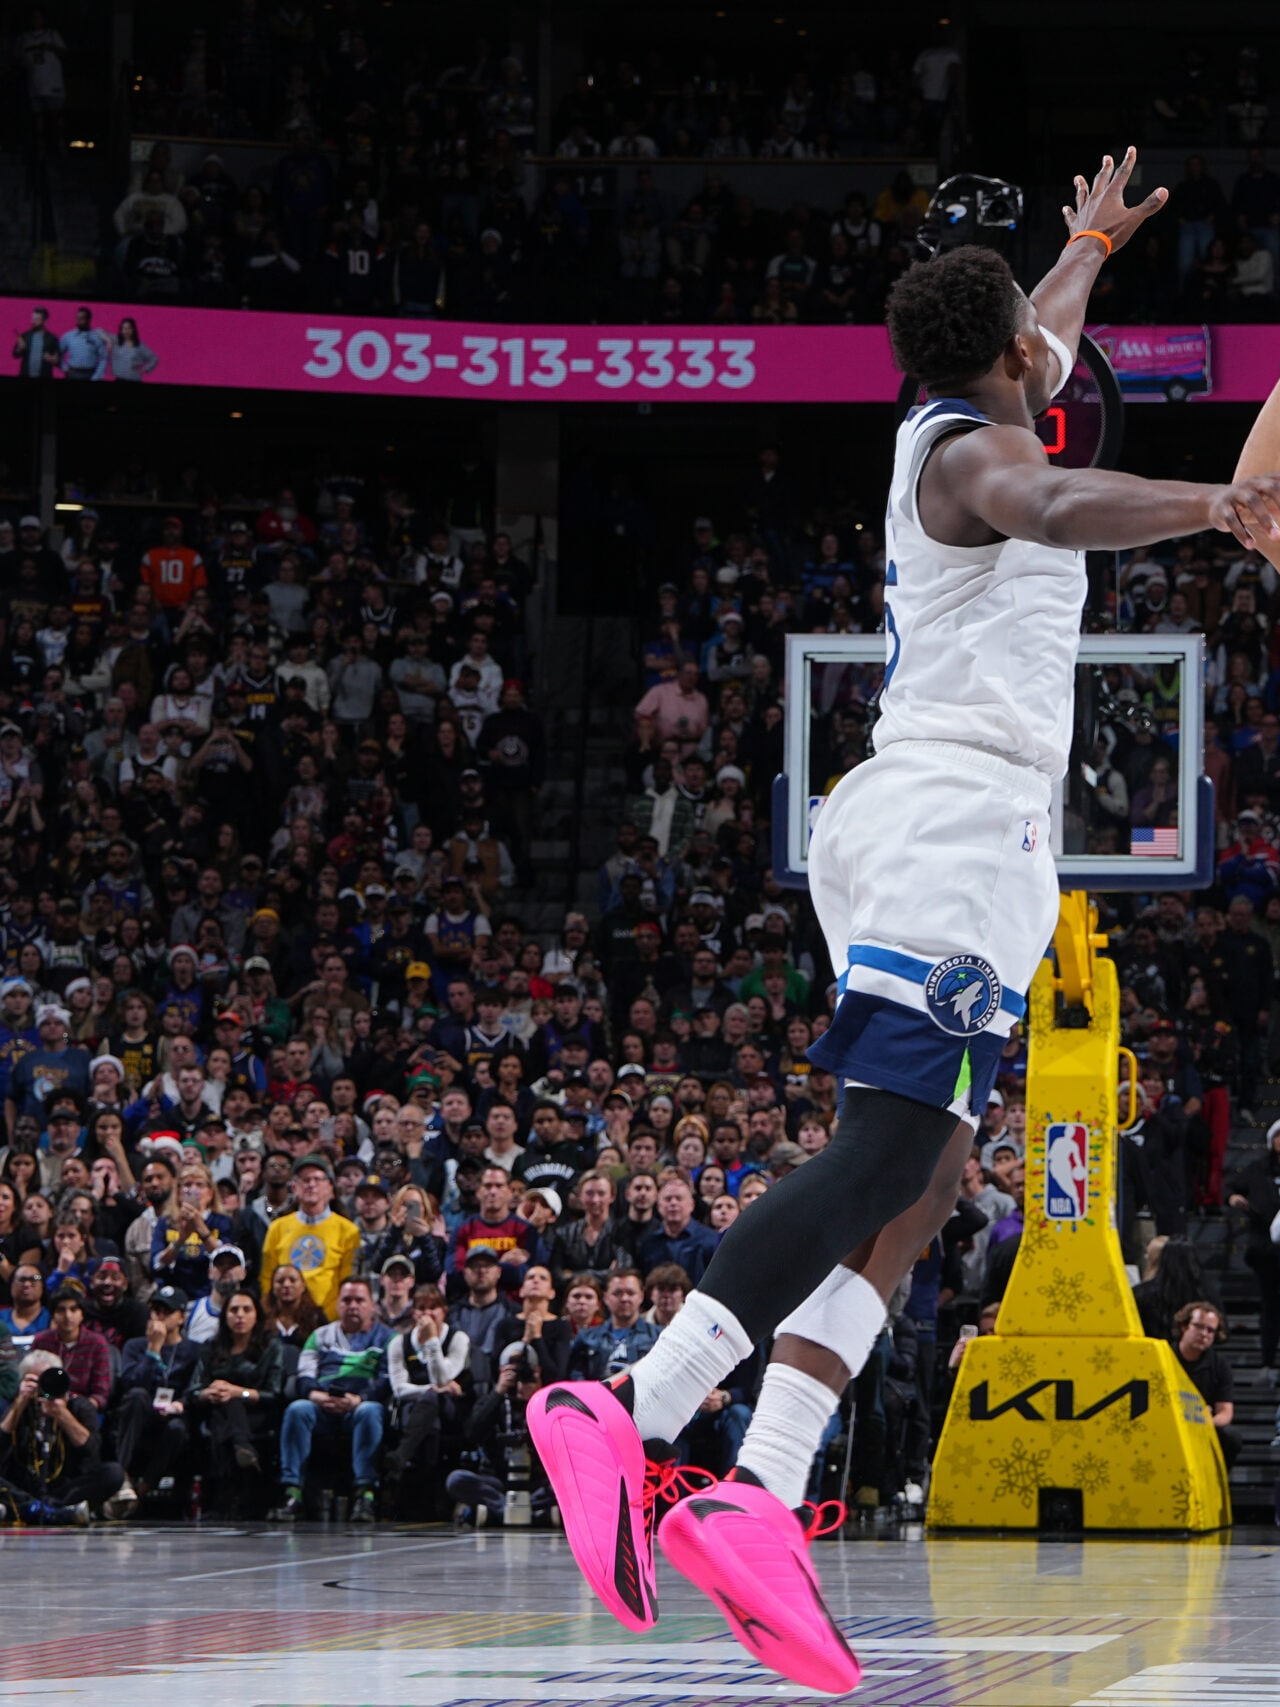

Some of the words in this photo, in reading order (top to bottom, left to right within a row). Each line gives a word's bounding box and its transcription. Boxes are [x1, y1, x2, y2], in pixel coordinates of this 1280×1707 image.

[576, 177, 605, 197] 14
[347, 249, 370, 275] 10
[303, 327, 756, 389] 303-313-3333
[159, 559, 183, 584] 10
[927, 955, 973, 996] MINNESOTA
[976, 959, 1000, 1030] TIMBERWOLVES
[969, 1379, 1149, 1421] KIA
